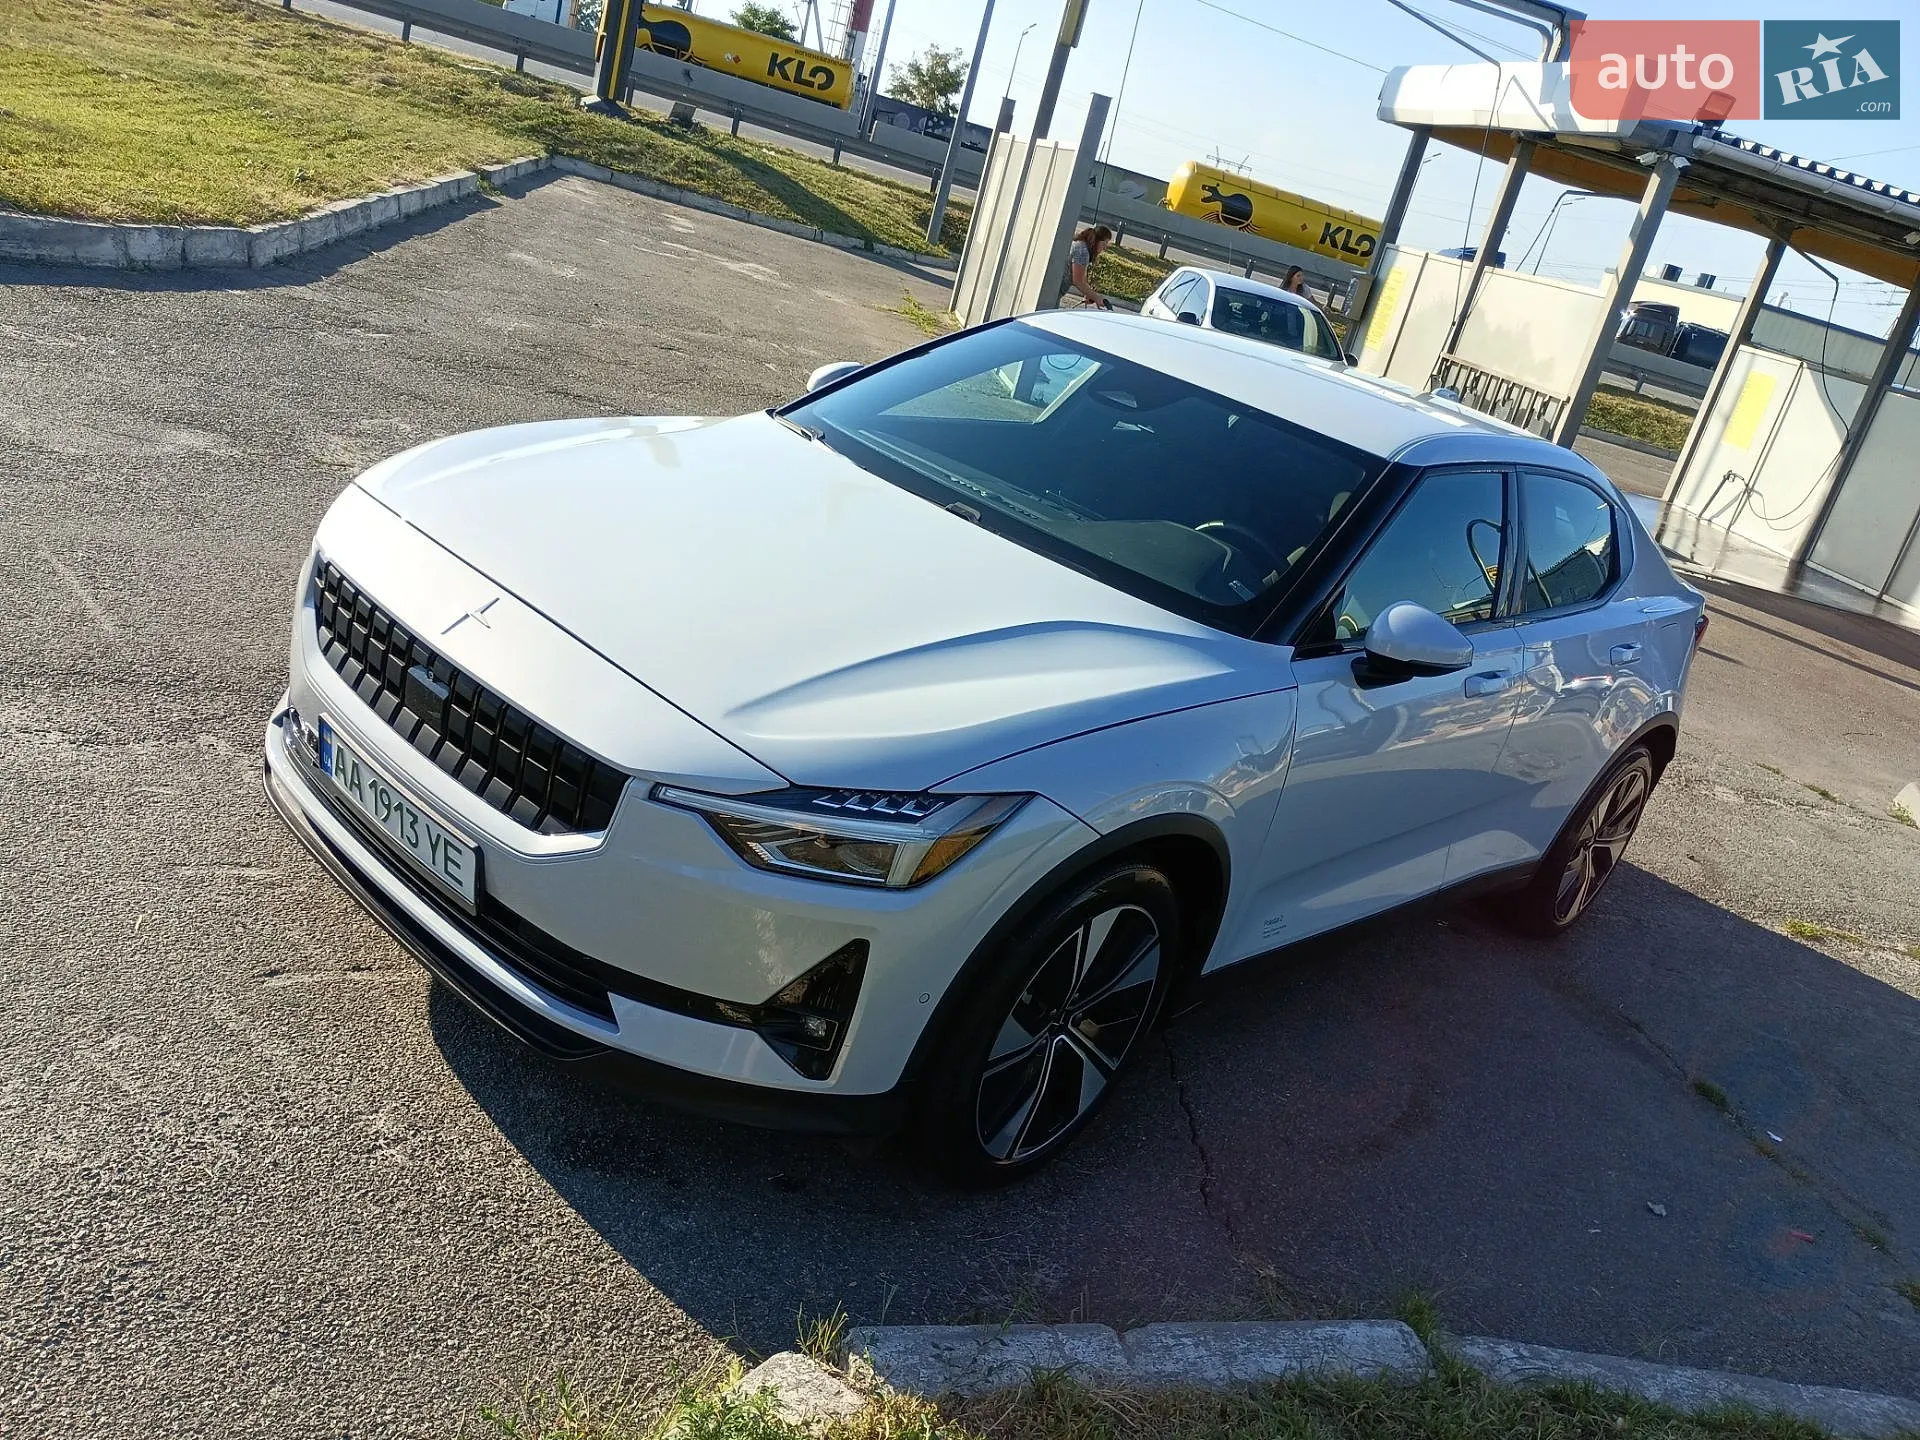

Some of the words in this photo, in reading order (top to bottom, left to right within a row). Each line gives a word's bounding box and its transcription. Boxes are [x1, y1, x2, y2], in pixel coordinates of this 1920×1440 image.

[767, 52, 835, 91] KLO
[1319, 222, 1376, 257] KLO
[334, 742, 363, 803] AA
[368, 777, 419, 849] 1913
[426, 823, 464, 888] YE
